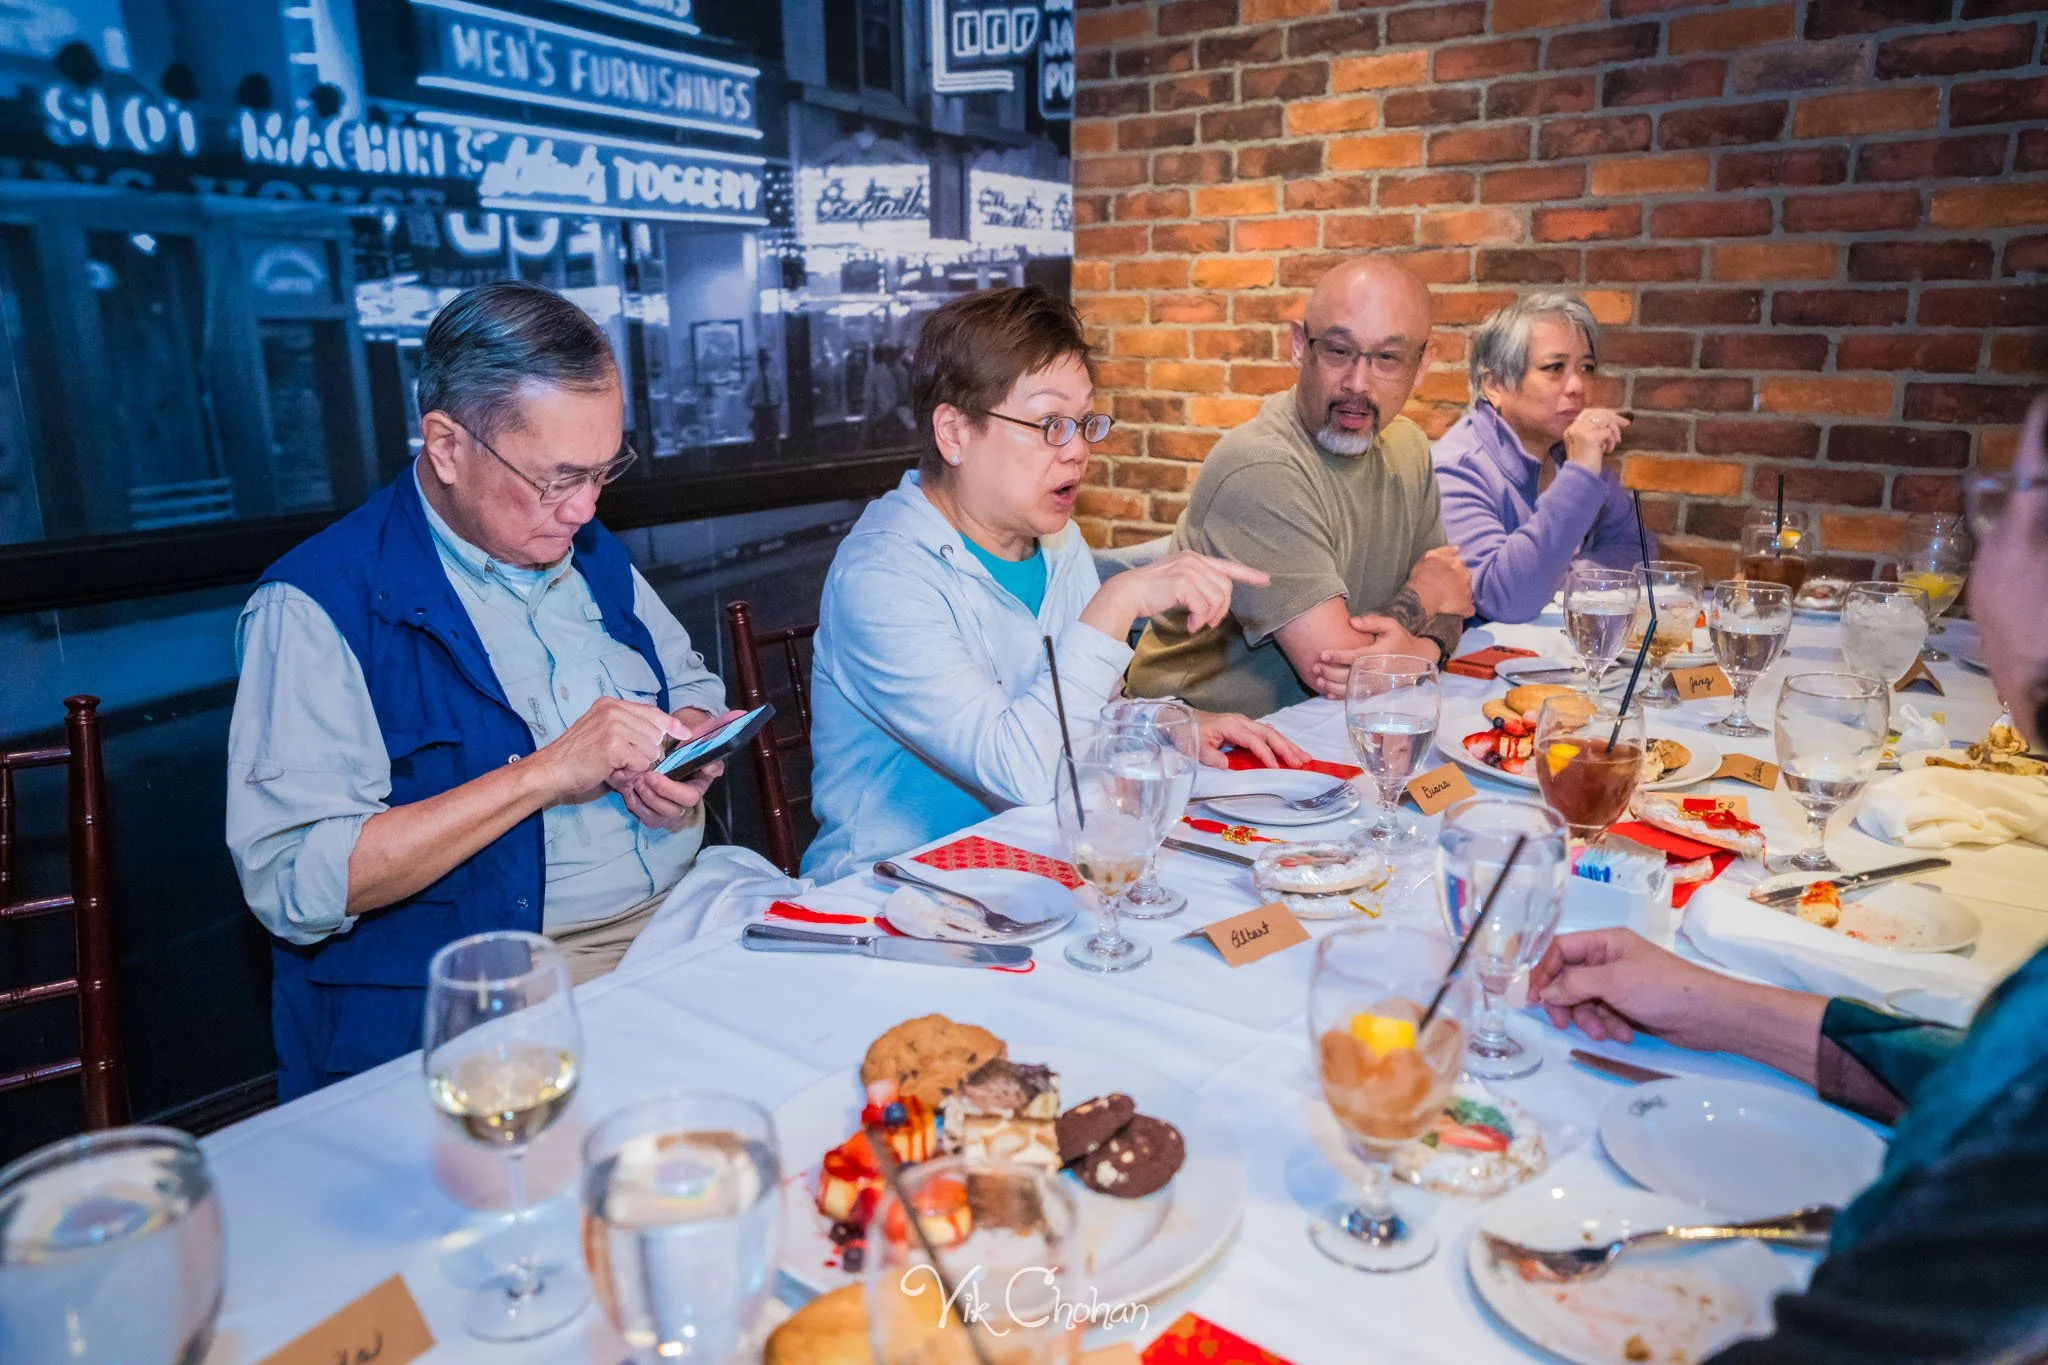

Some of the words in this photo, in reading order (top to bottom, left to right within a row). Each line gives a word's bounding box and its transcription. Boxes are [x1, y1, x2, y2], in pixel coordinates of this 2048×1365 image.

[452, 23, 556, 88] MEN'S
[569, 49, 752, 122] FURNISHINGS
[612, 155, 761, 212] TOGGERY
[1421, 780, 1451, 799] Diana
[1231, 920, 1270, 948] Albert
